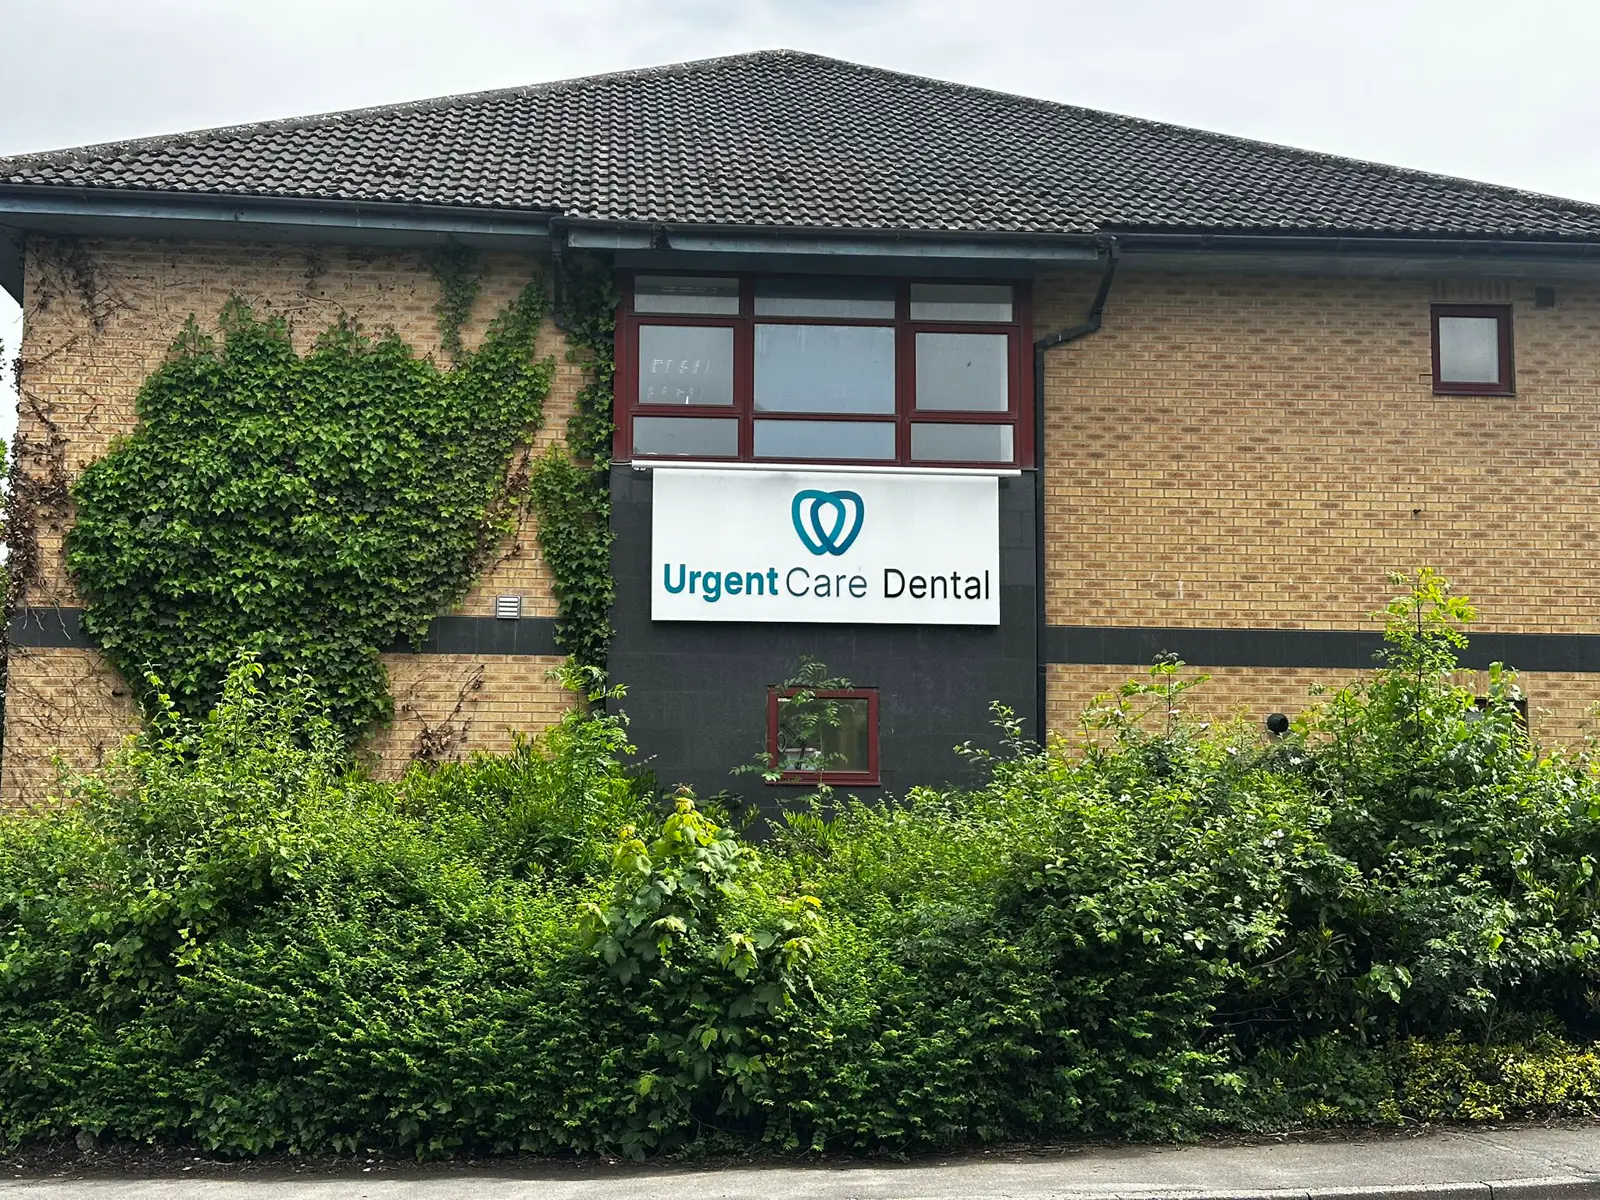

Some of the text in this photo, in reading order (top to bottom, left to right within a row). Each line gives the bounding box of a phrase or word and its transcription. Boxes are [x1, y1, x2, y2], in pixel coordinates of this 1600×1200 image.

[663, 563, 990, 604] Urgent Care Dental
